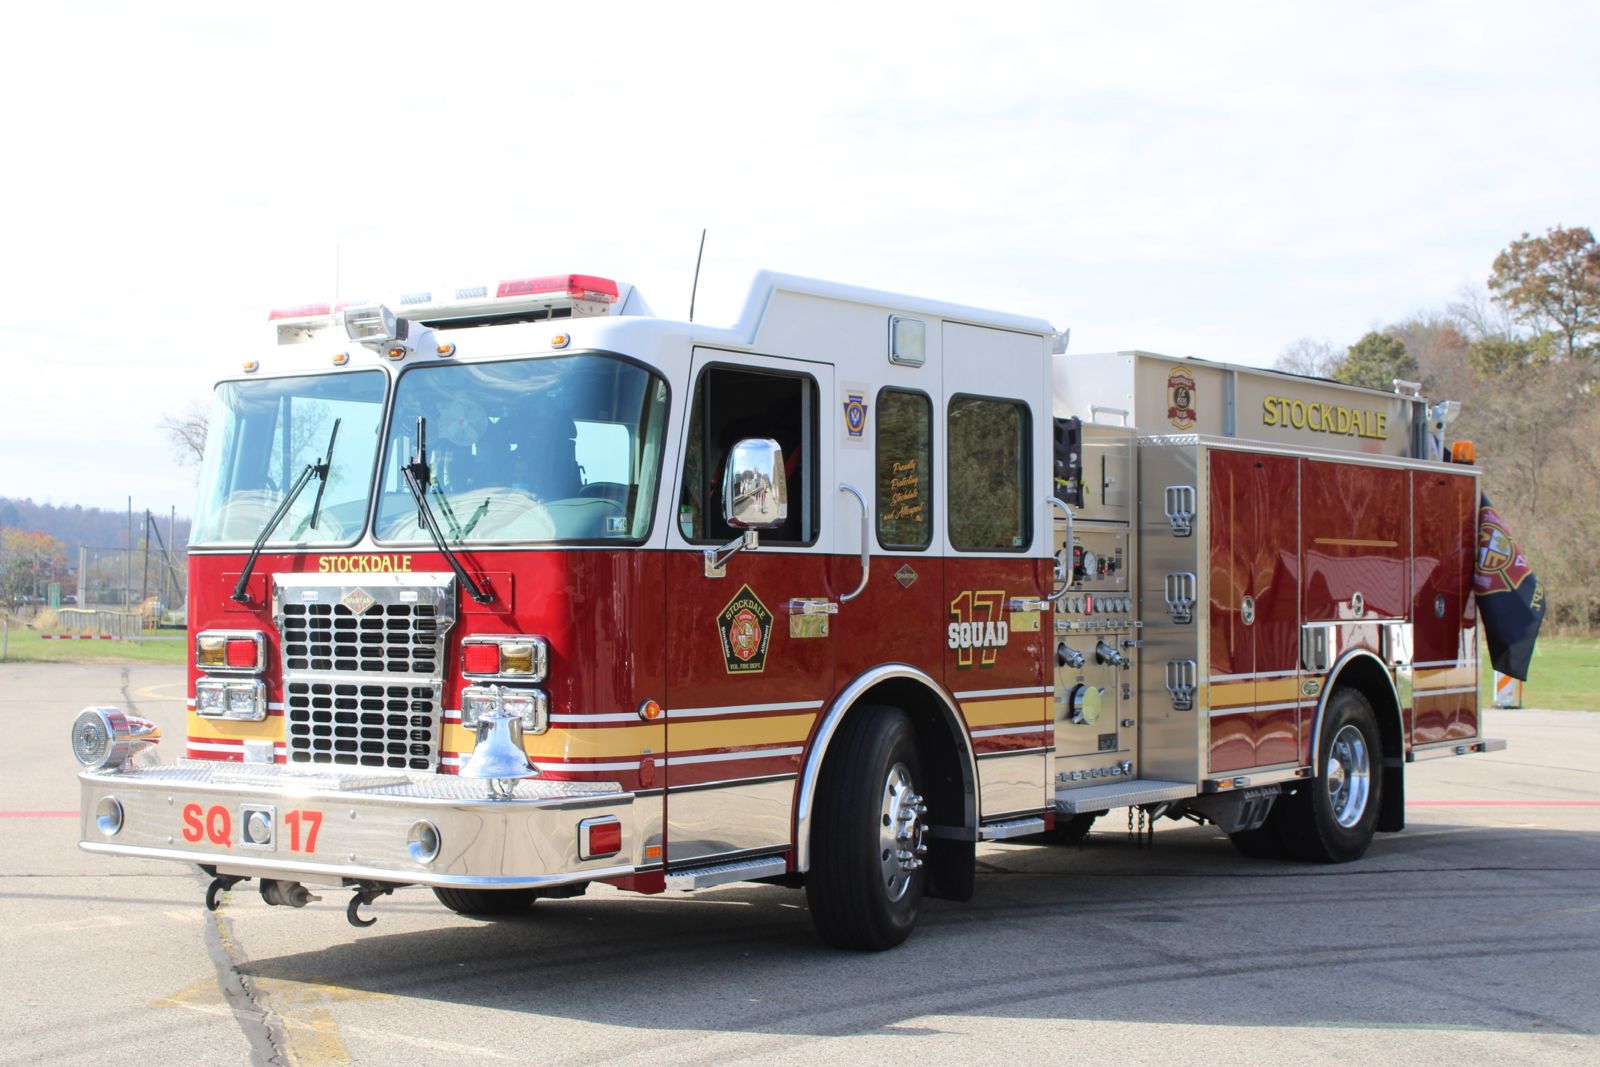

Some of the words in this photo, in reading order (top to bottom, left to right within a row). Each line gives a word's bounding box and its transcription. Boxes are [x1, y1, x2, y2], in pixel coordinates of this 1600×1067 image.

[1263, 396, 1388, 440] STOCKDALE
[318, 555, 412, 572] STOCKDALE
[726, 600, 766, 620] STOCKDALE
[951, 590, 1006, 666] 17
[948, 620, 1008, 649] SQUAD
[182, 803, 232, 848] SQ
[284, 810, 324, 853] 17
